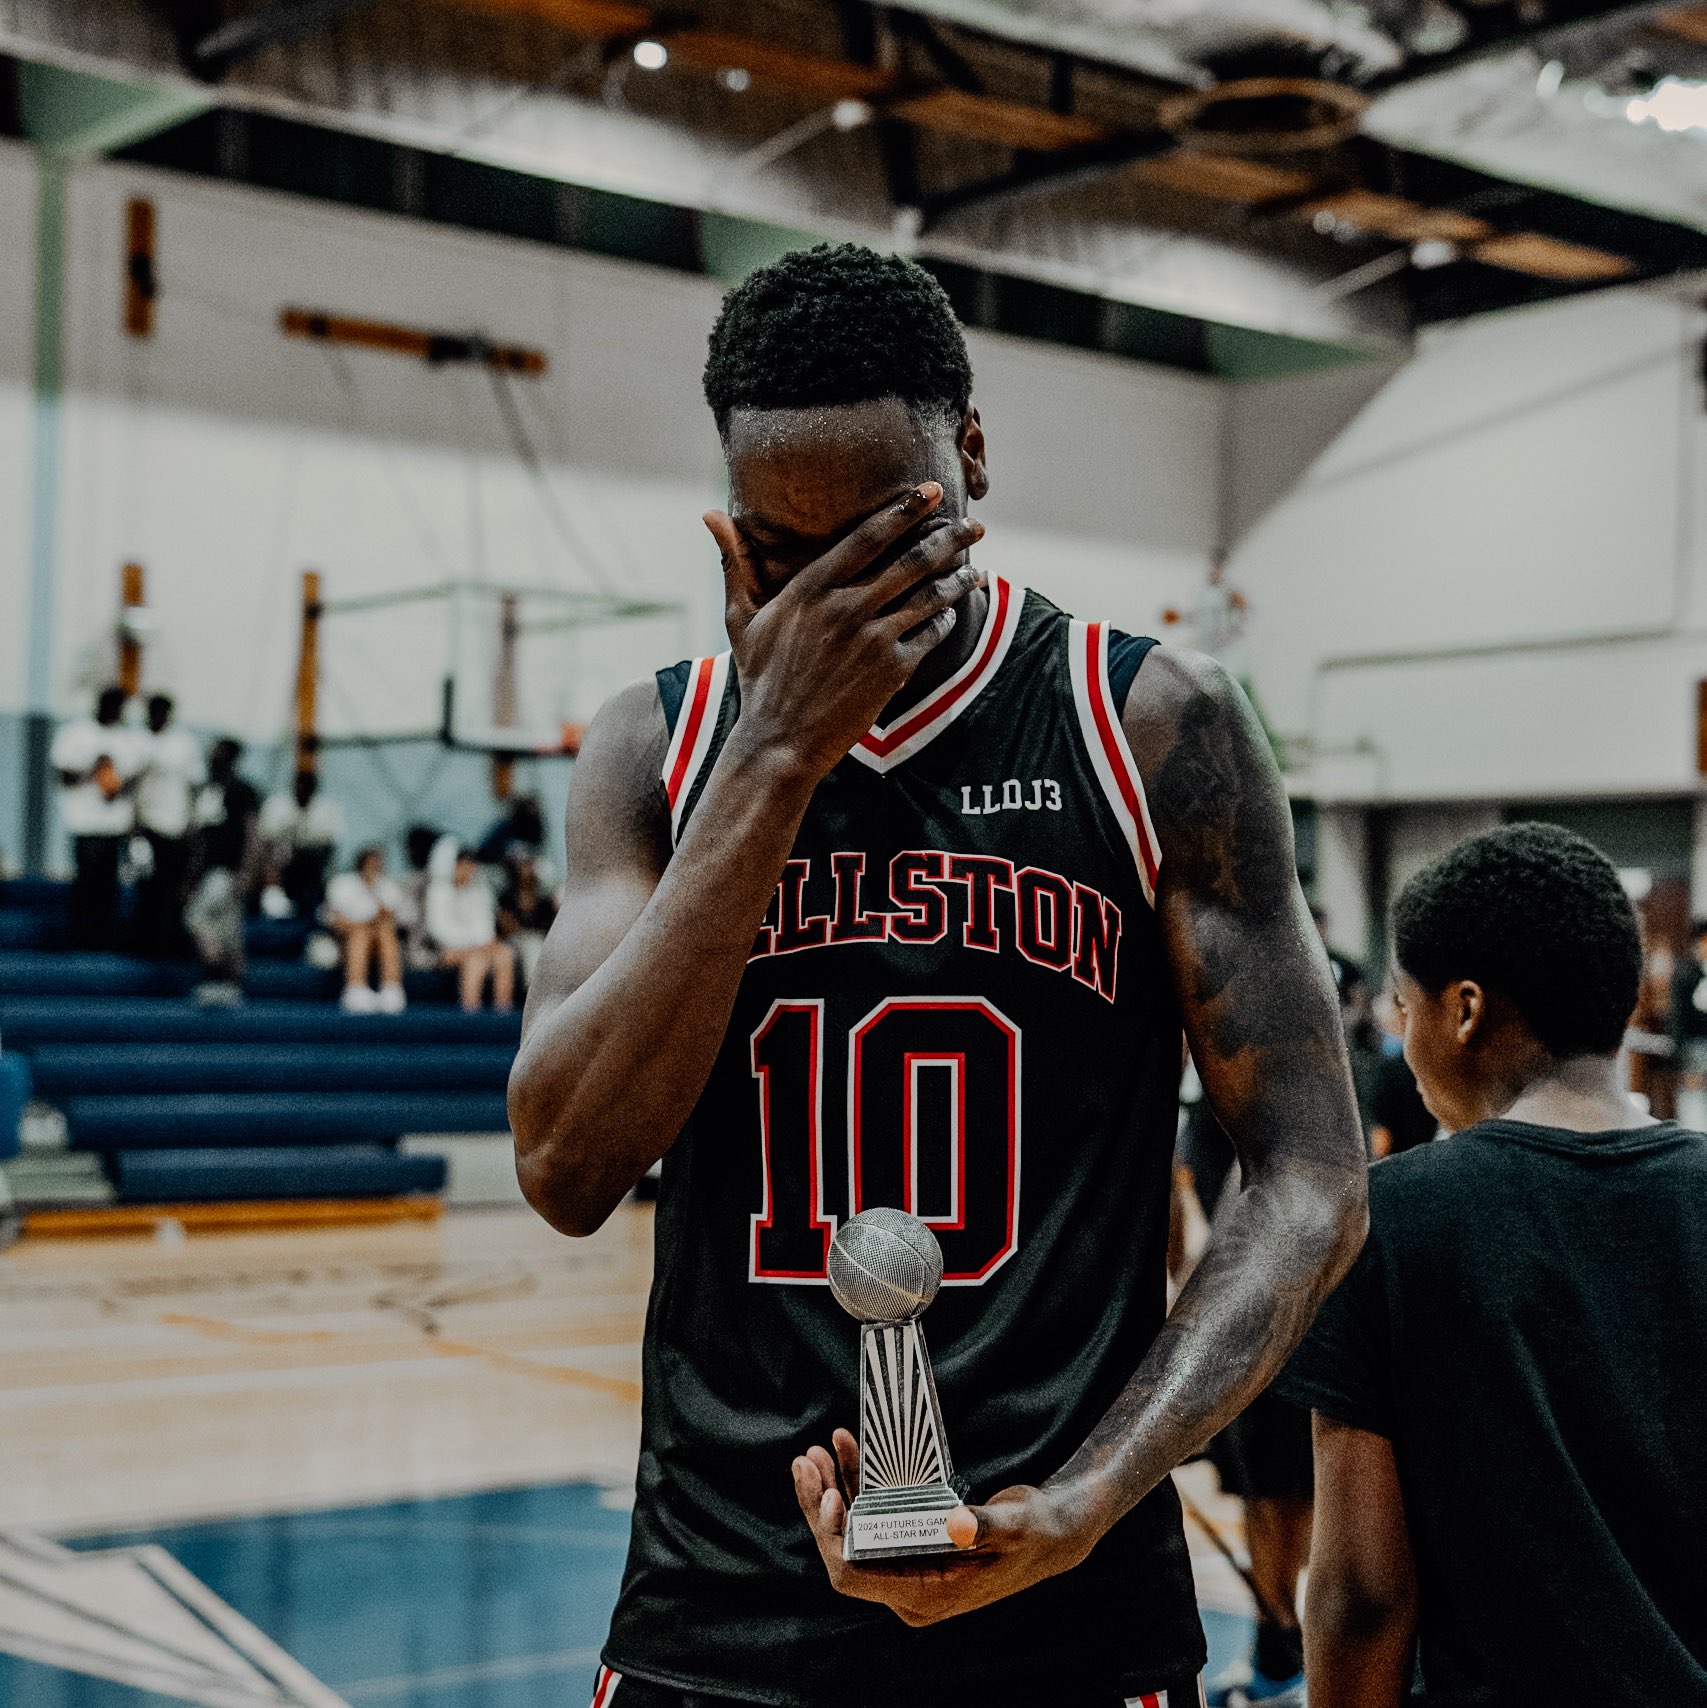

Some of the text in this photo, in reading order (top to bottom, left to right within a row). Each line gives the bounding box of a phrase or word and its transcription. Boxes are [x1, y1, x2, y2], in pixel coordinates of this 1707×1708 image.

[747, 850, 1121, 1003] LLSTON
[749, 996, 1022, 1286] 10
[858, 1517, 947, 1531] 2024 FUTURES GAM
[873, 1528, 939, 1540] ALL-STAR MVP
